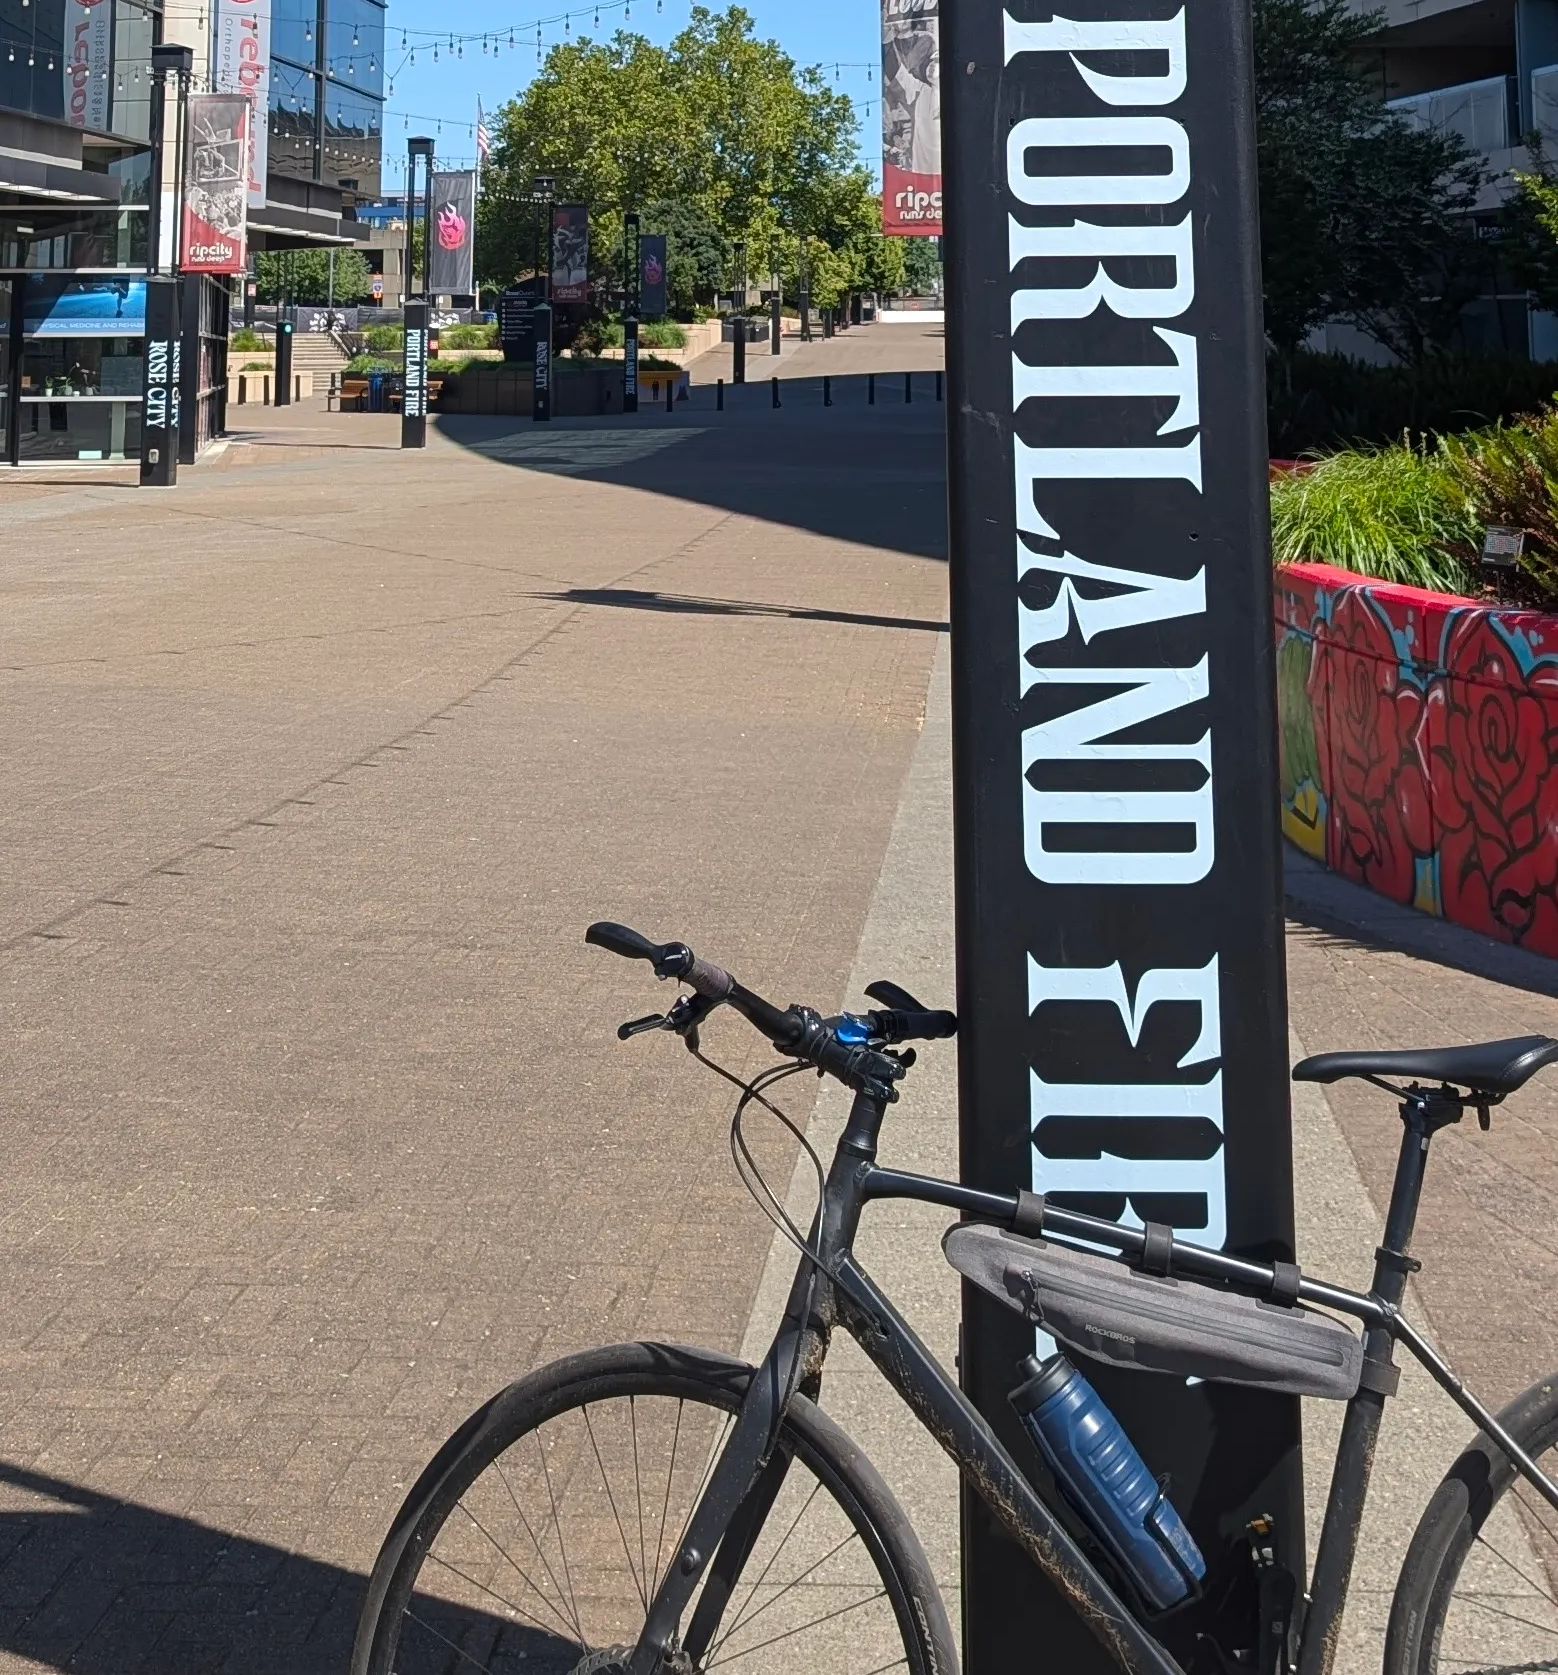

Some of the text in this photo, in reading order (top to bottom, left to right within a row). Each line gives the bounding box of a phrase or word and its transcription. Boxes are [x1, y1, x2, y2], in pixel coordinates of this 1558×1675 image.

[190, 242, 233, 259] ripcity
[900, 211, 924, 220] runs
[146, 340, 168, 429] ROSE CITY
[171, 340, 181, 428] ROSE CITY
[405, 329, 421, 417] PORTLAND FIRE
[1003, 4, 1230, 1385] PORTLAND FIR
[1085, 1324, 1136, 1344] ROCKBROS
